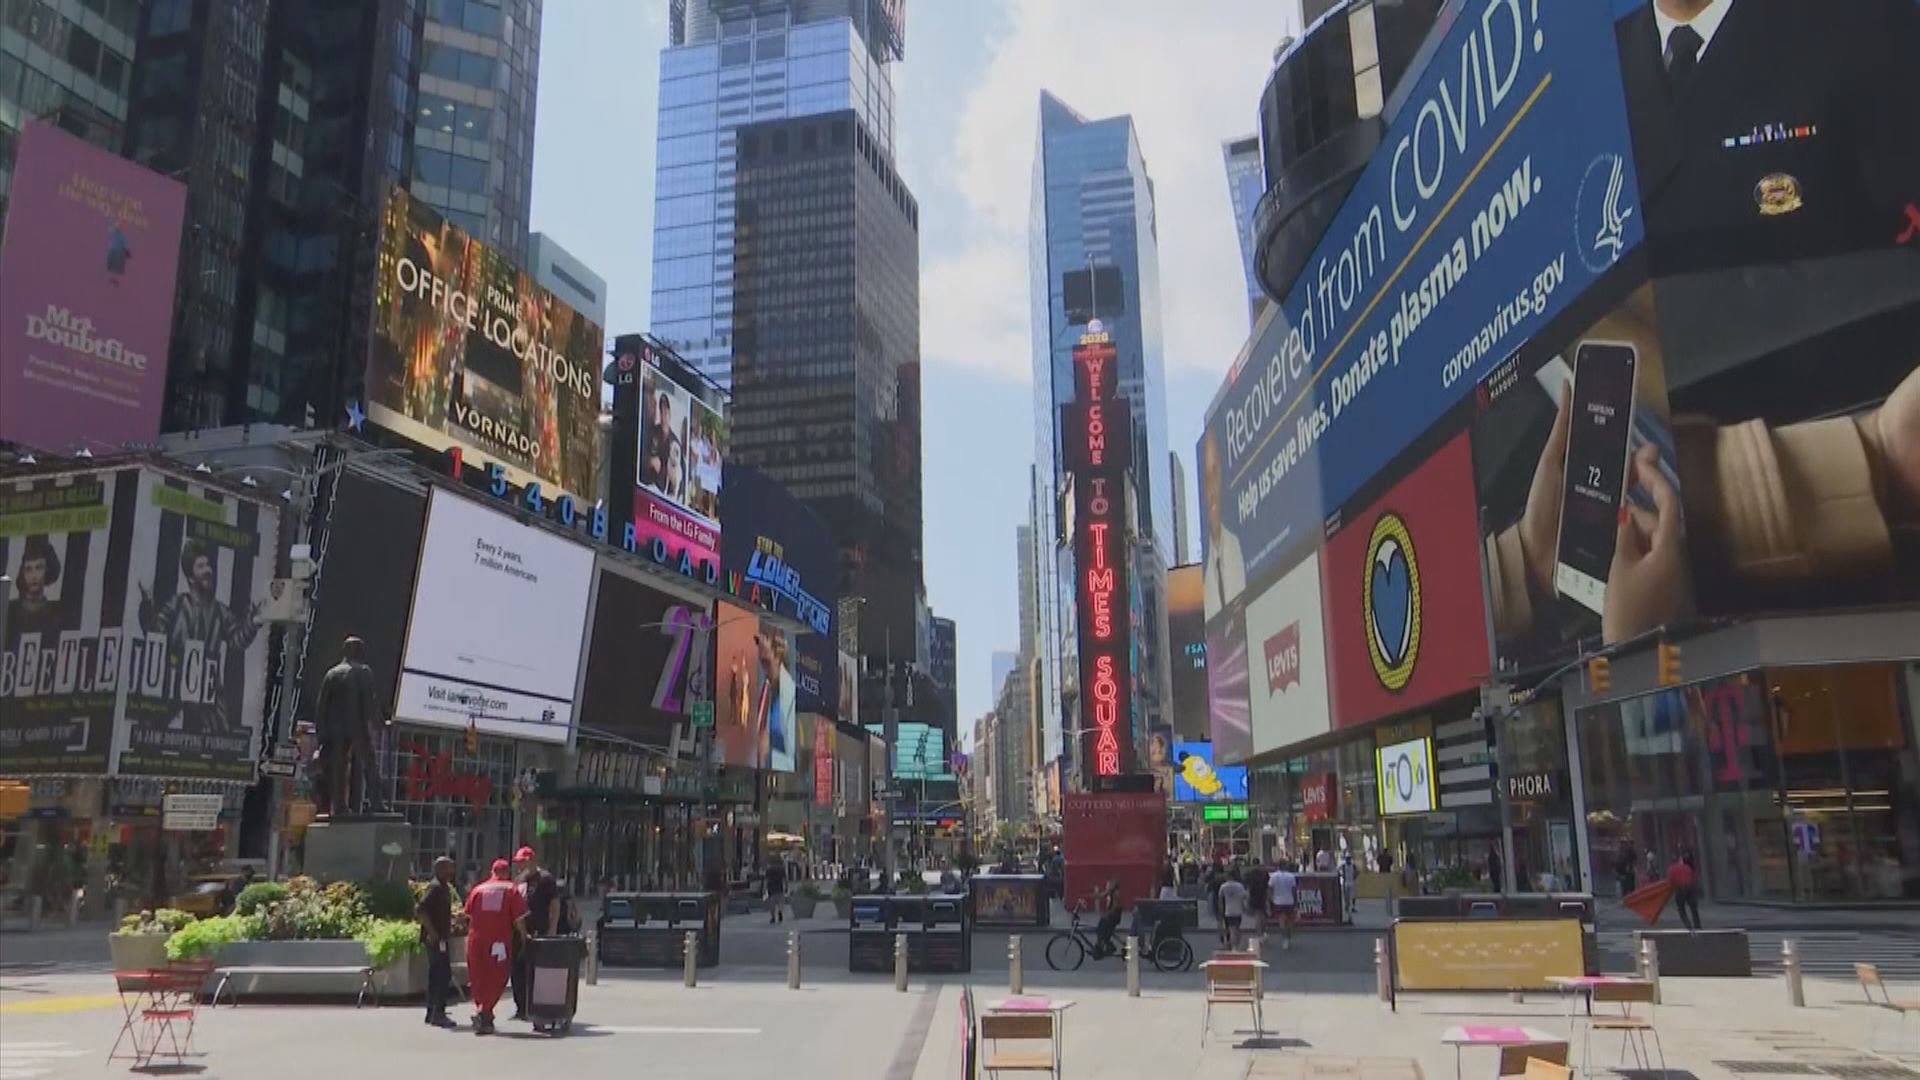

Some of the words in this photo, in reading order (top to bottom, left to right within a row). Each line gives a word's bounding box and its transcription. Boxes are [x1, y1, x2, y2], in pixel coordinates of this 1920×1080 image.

[1226, 283, 1316, 467] Recovered
[1317, 204, 1385, 340] from
[1391, 0, 1543, 232] COVID!
[487, 285, 521, 320] PRIME
[1442, 251, 1567, 389] coronavirus.gov
[25, 314, 147, 370] Doubtfire
[396, 257, 478, 331] OFFICE
[483, 308, 592, 399] LOCATIONS
[1238, 478, 1258, 523] Help
[1257, 472, 1272, 501] us
[1270, 440, 1297, 482] save
[1297, 400, 1331, 455] lives.
[1330, 328, 1388, 420] Donate
[1391, 235, 1468, 367] plasma
[1472, 155, 1542, 261] now.
[618, 372, 633, 385] LG
[455, 400, 541, 458] VORNADO
[1085, 357, 1105, 466] WELCOME
[1090, 478, 1109, 516] TO
[1588, 464, 1601, 487] 72
[476, 537, 497, 556] Every
[649, 502, 670, 525] From
[670, 513, 683, 532] the
[683, 520, 693, 538] LG
[693, 524, 716, 552] Family
[479, 557, 504, 571] million
[747, 549, 801, 598] LOWER
[1088, 522, 1114, 638] TIMES
[428, 684, 447, 701] Visit
